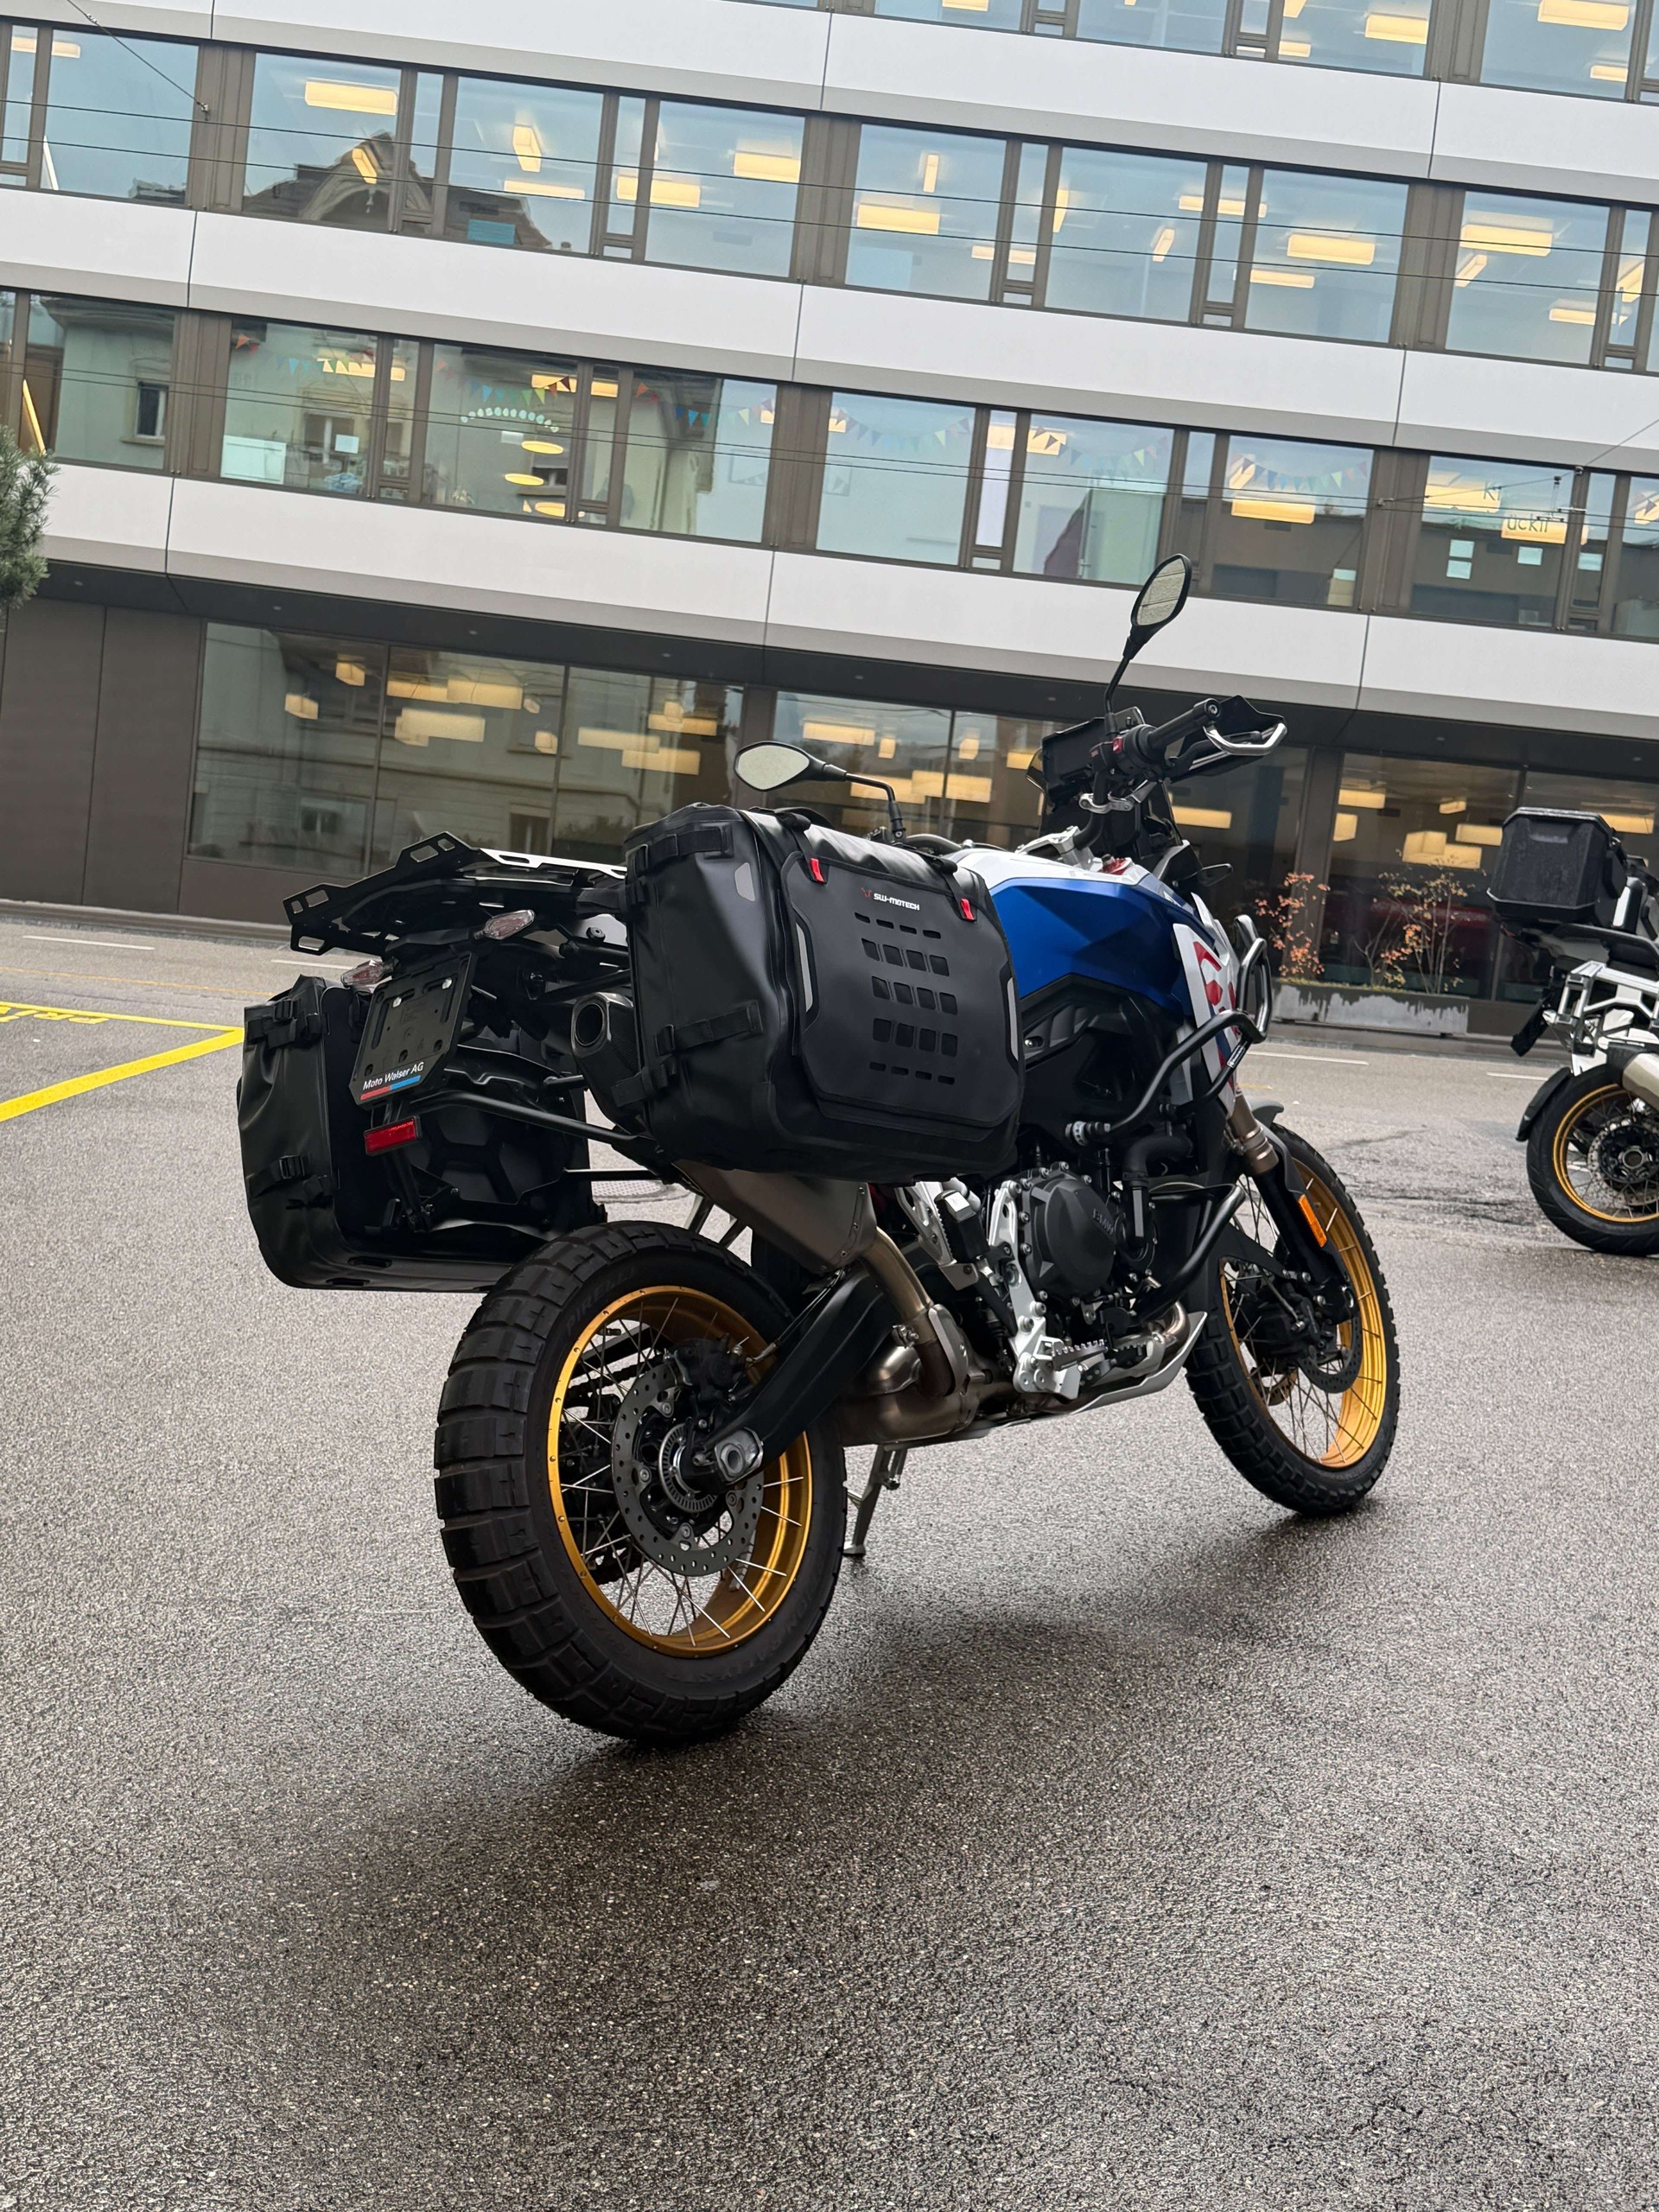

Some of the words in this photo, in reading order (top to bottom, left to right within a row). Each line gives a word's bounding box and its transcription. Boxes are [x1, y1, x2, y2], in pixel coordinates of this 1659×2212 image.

[873, 893, 920, 911] SW-MOTECH
[362, 1077, 383, 1090] Moto
[385, 1067, 410, 1084] Walser
[410, 1061, 424, 1074] AG
